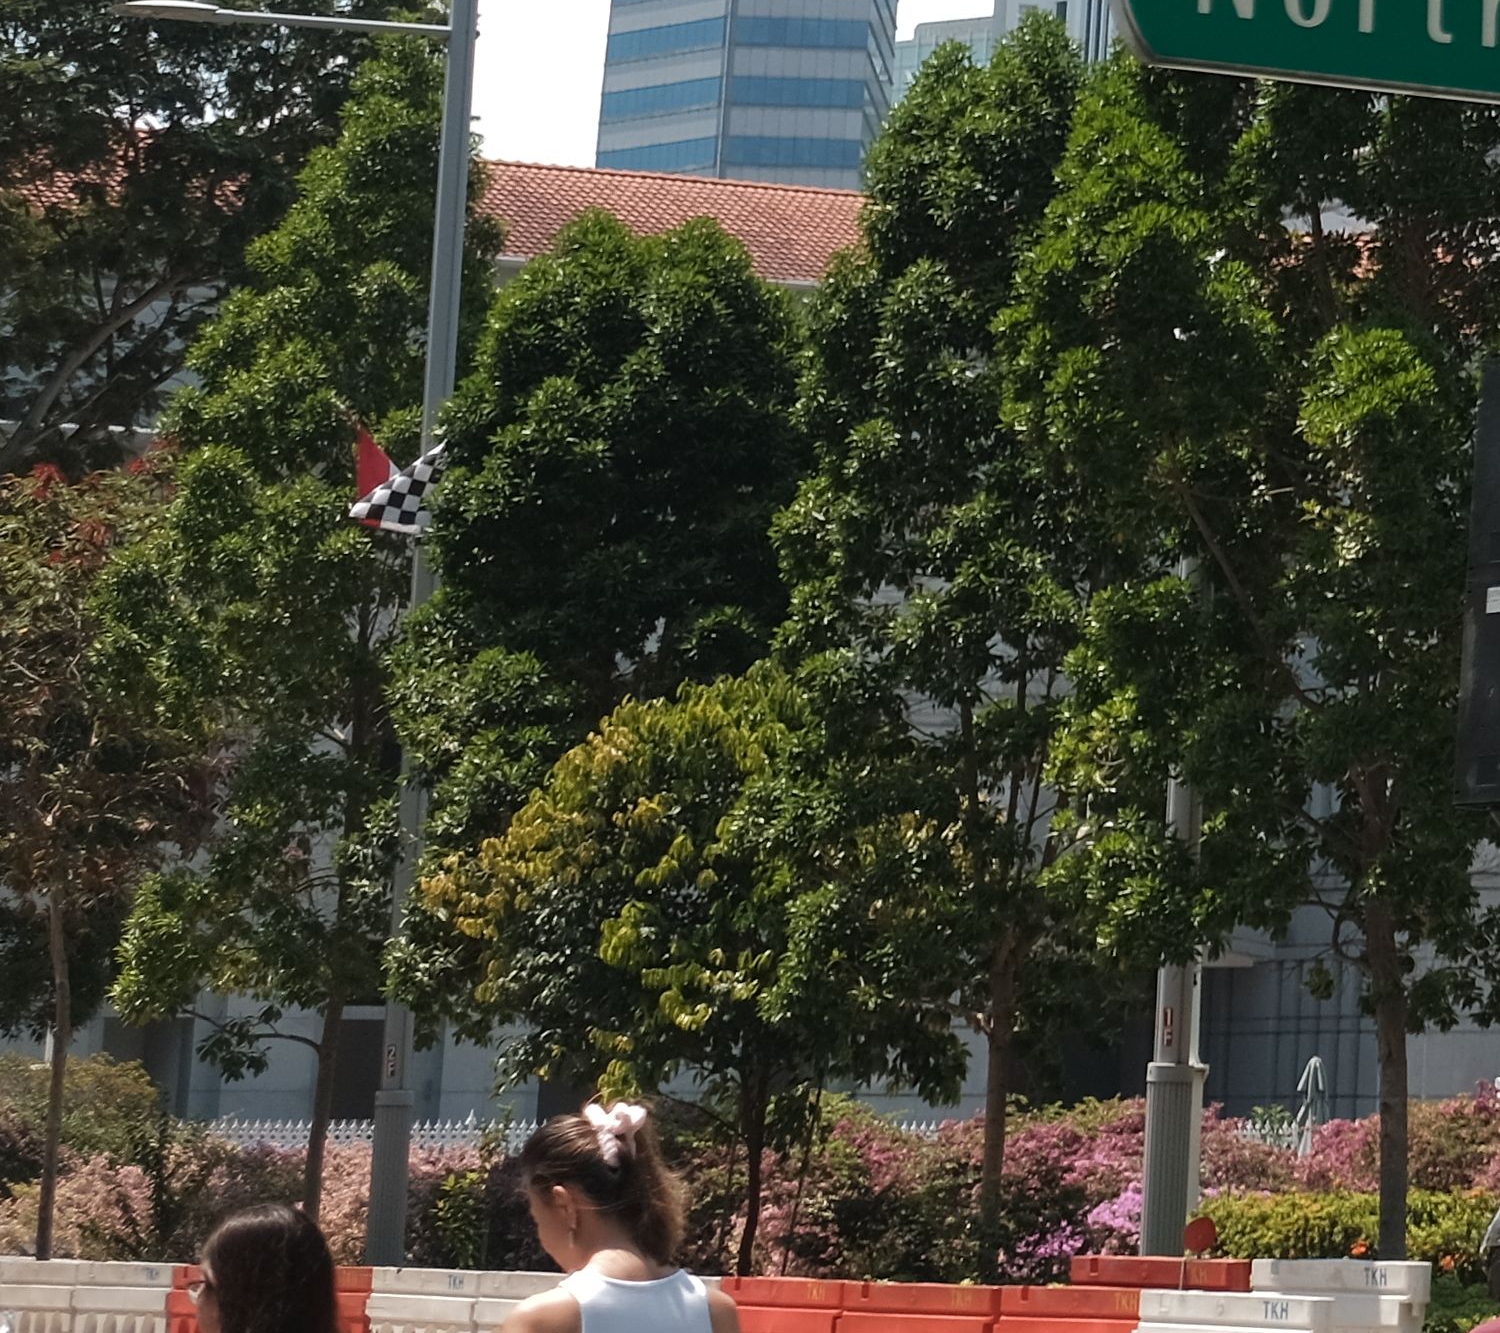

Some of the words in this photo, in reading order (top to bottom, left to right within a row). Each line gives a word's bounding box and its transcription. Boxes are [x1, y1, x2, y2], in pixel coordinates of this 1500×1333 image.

[1364, 1267, 1388, 1286] TKH
[1114, 1293, 1138, 1311] TKH
[1263, 1301, 1289, 1321] TKH
